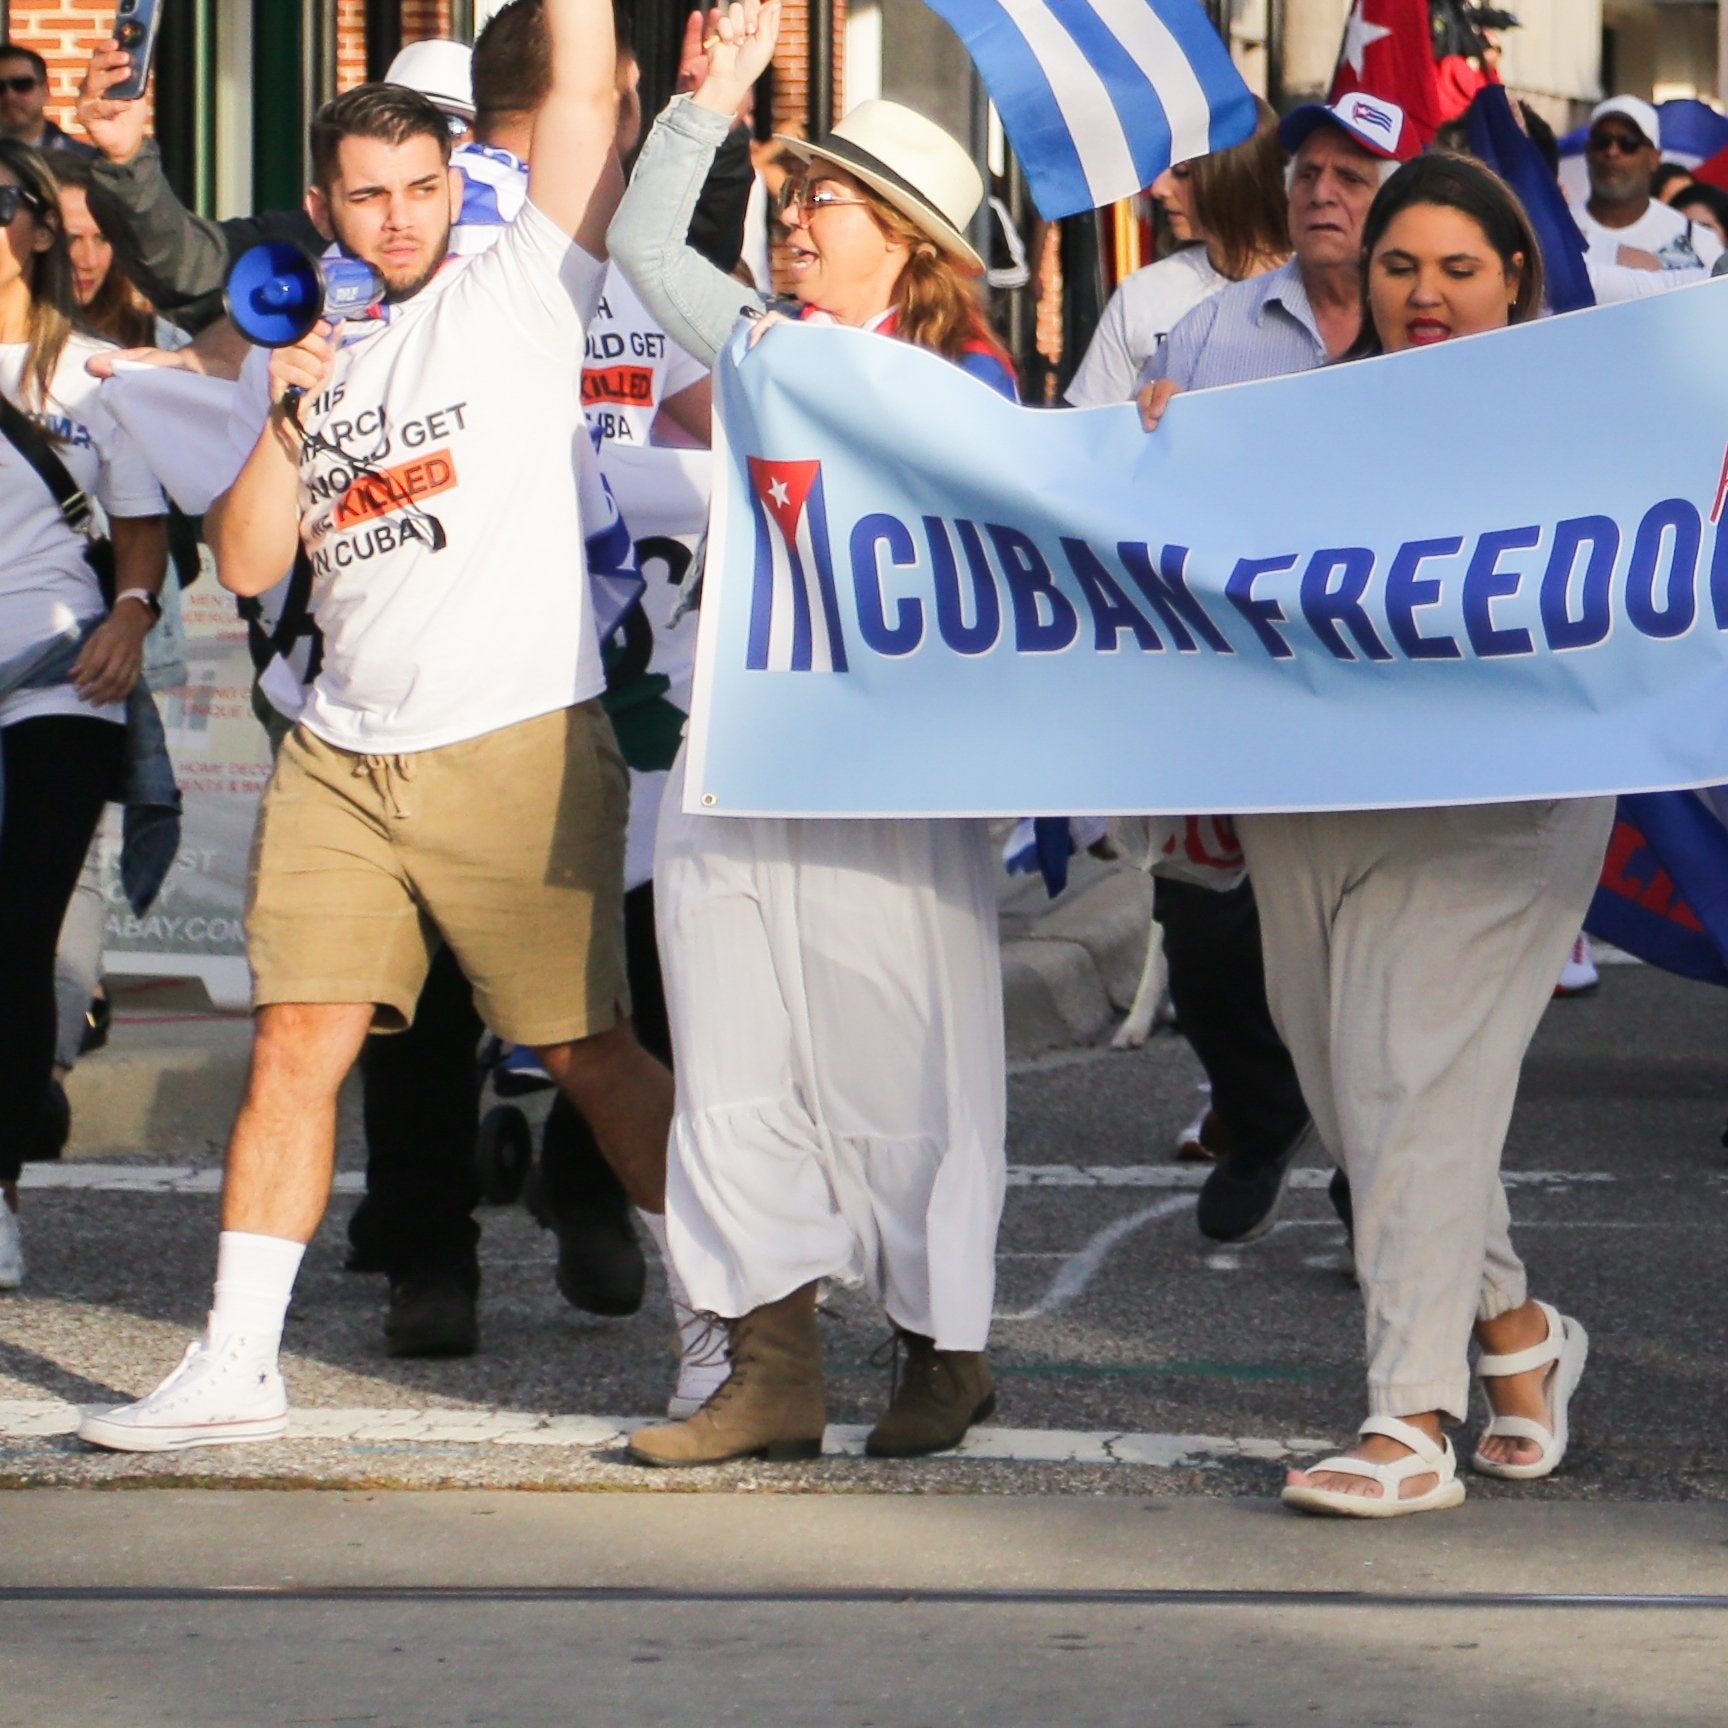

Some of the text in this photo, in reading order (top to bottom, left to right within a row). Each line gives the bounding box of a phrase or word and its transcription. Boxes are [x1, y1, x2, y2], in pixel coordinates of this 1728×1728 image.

[629, 331, 666, 359] GET
[401, 401, 467, 448] GET
[336, 458, 452, 522] KILLED
[334, 518, 424, 568] CUBA
[848, 512, 1235, 659] CUBAN
[229, 761, 273, 775] DECO
[107, 914, 246, 944] ABAY.COM
